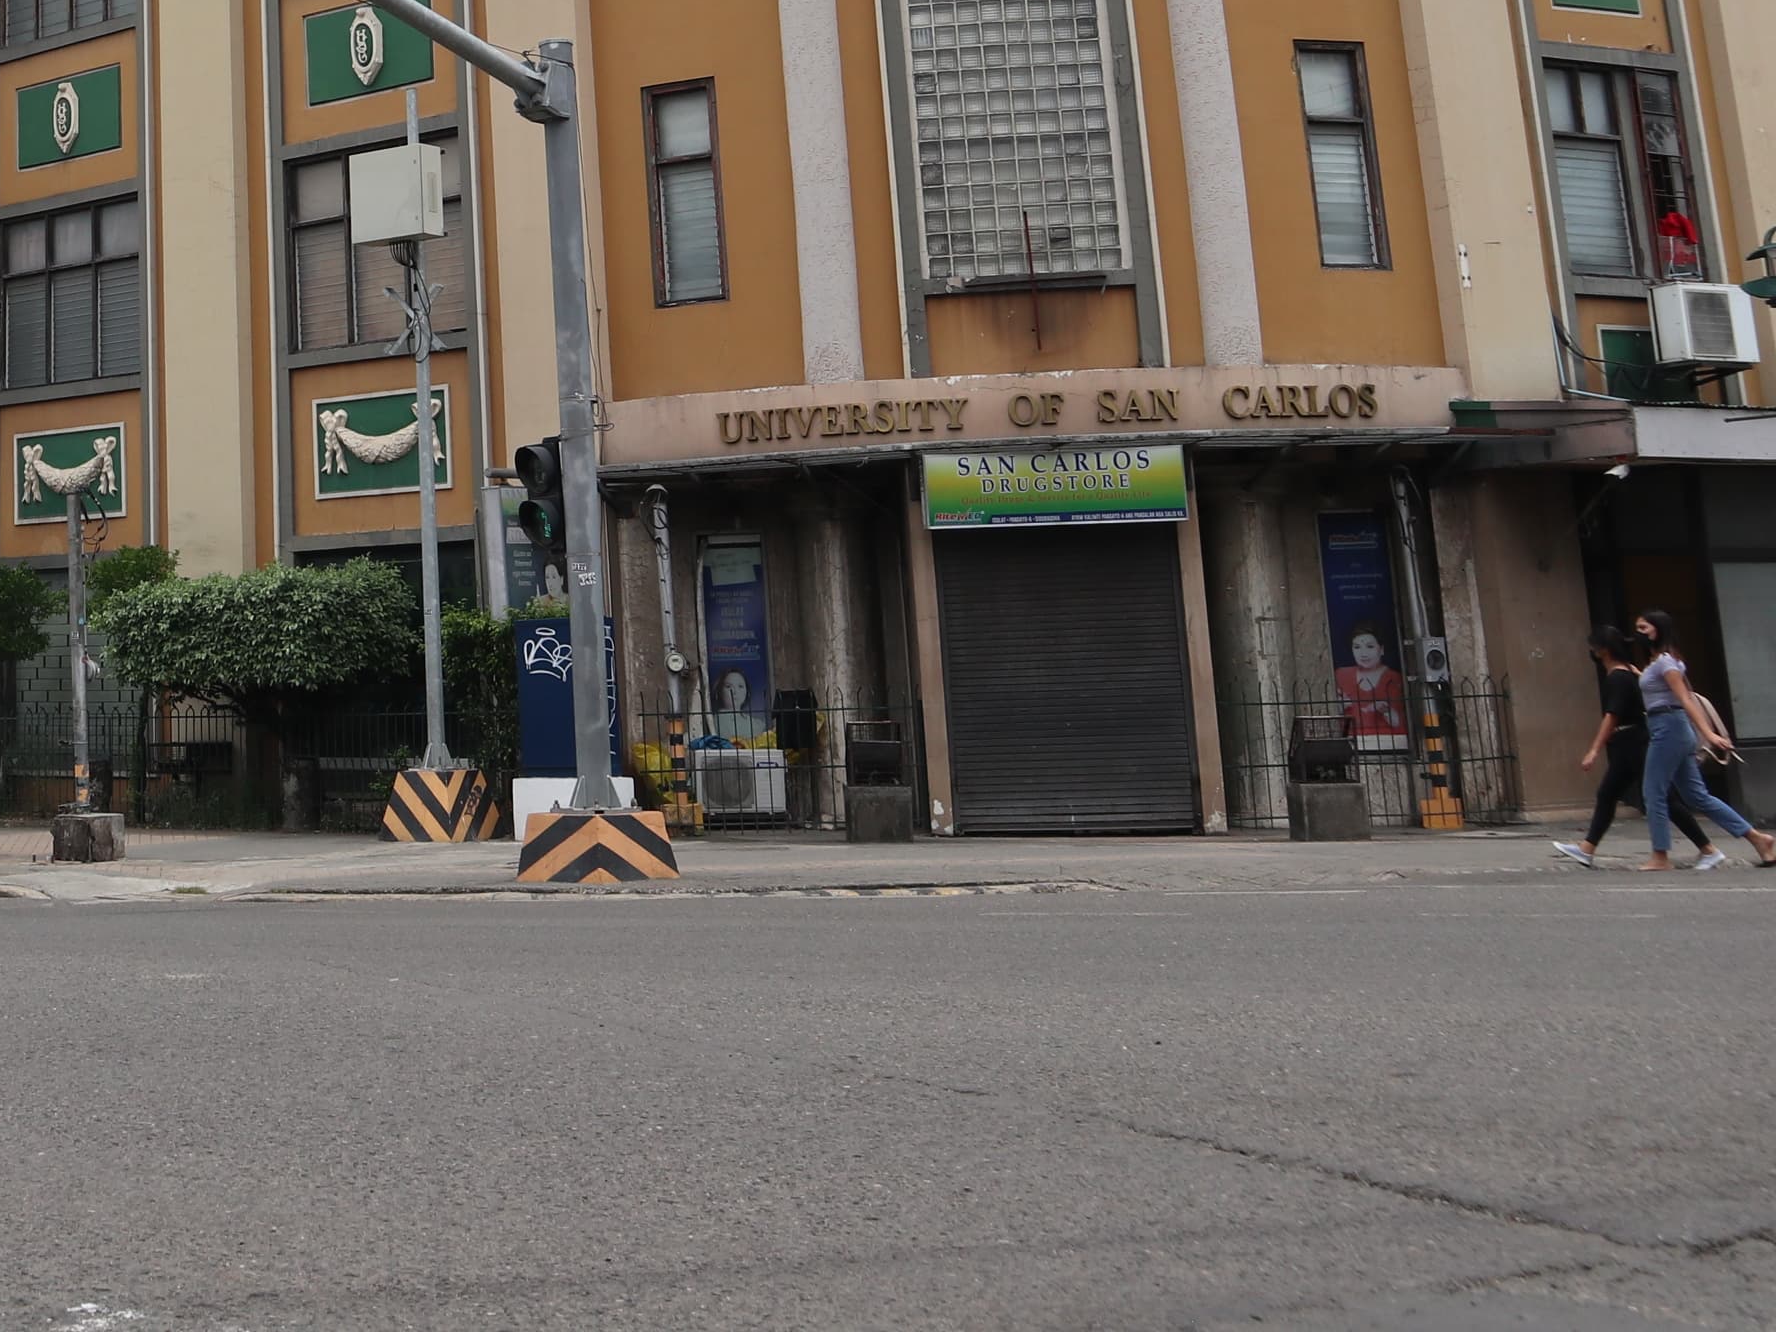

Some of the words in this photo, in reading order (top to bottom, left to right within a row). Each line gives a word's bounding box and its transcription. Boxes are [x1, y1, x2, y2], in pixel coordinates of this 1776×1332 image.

[716, 397, 968, 443] UNIVERSITY
[1007, 392, 1065, 427] OF
[1097, 388, 1181, 422] SAN
[1222, 383, 1379, 419] CARLOS
[957, 455, 1016, 477] SAN
[1030, 449, 1150, 475] CARLOS
[981, 473, 1130, 493] DRUGSTORE
